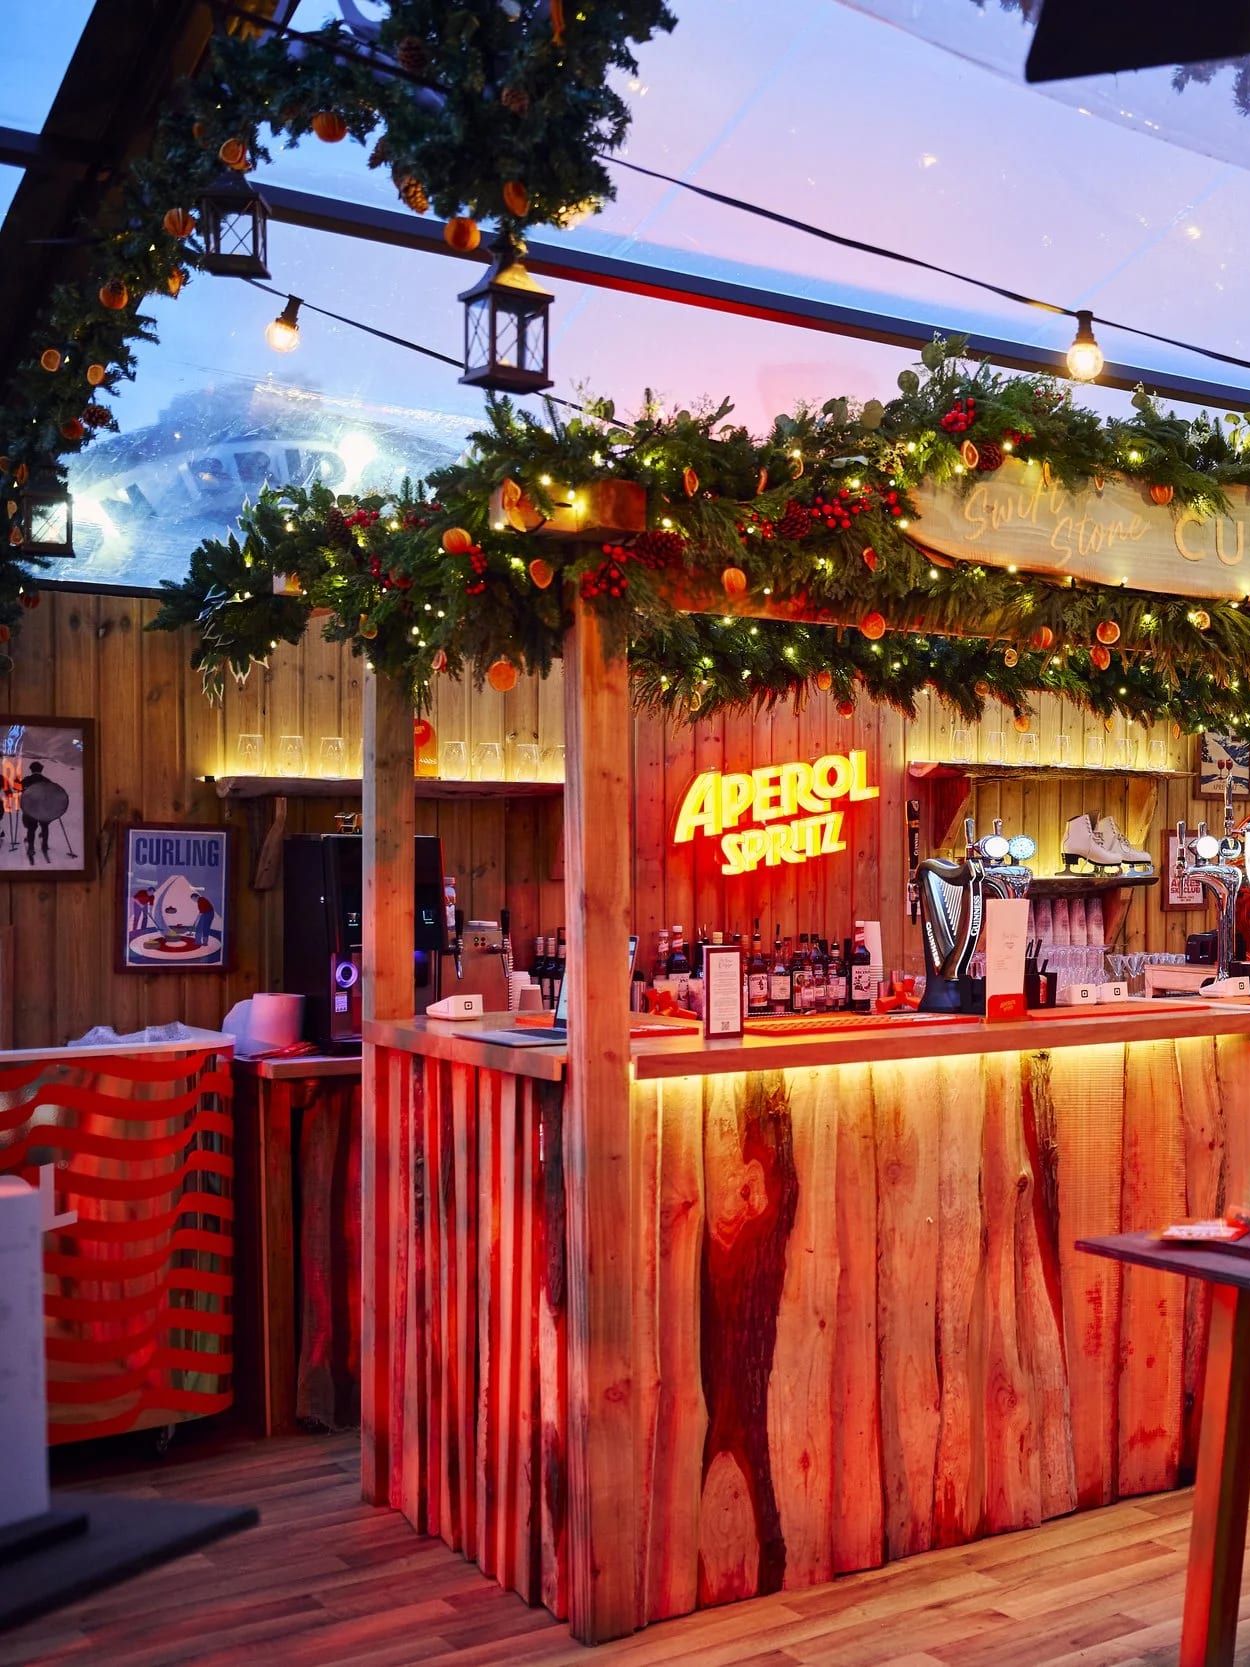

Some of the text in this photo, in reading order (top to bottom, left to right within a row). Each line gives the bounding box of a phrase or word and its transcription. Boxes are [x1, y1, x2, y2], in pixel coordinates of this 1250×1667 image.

[1050, 512, 1150, 568] Stone
[672, 749, 880, 844] APEROL
[135, 838, 219, 867] CURLING
[720, 811, 847, 876] SPRITZ
[1171, 879, 1200, 887] ARES
[970, 895, 982, 937] GUINNESS
[925, 921, 942, 968] GUINNESS
